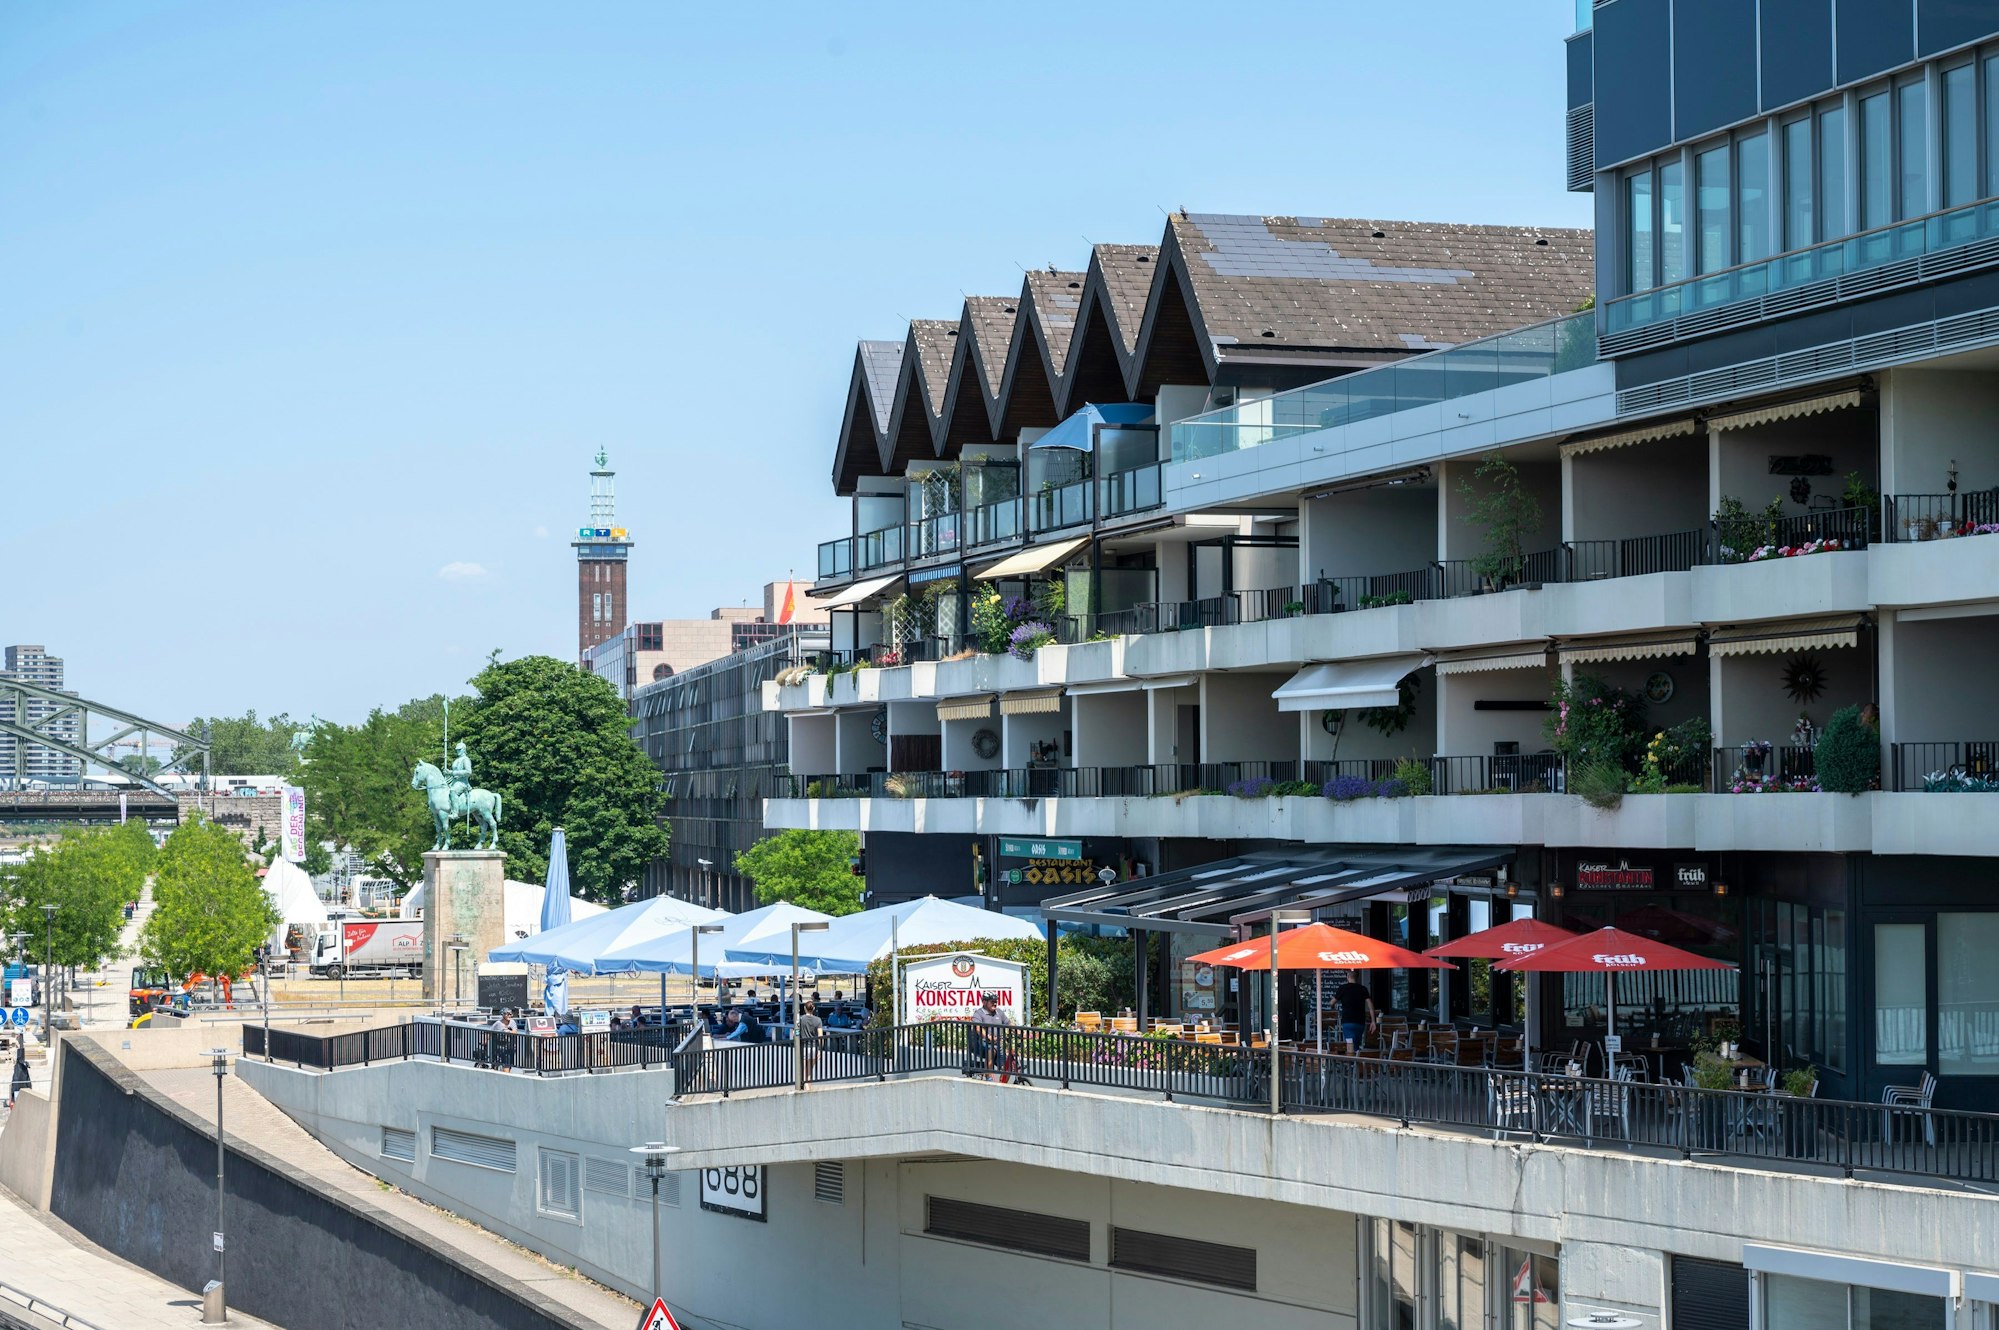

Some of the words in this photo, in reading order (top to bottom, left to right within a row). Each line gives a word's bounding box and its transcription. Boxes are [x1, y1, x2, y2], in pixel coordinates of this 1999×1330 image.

[582, 529, 623, 537] RTL
[290, 815, 298, 835] DER
[1579, 863, 1607, 873] KAISER
[1026, 867, 1096, 885] OASIS
[1578, 871, 1653, 884] KONSTANTIN
[1677, 868, 1706, 883] früh
[1592, 954, 1646, 965] früh
[915, 978, 952, 991] KAISER
